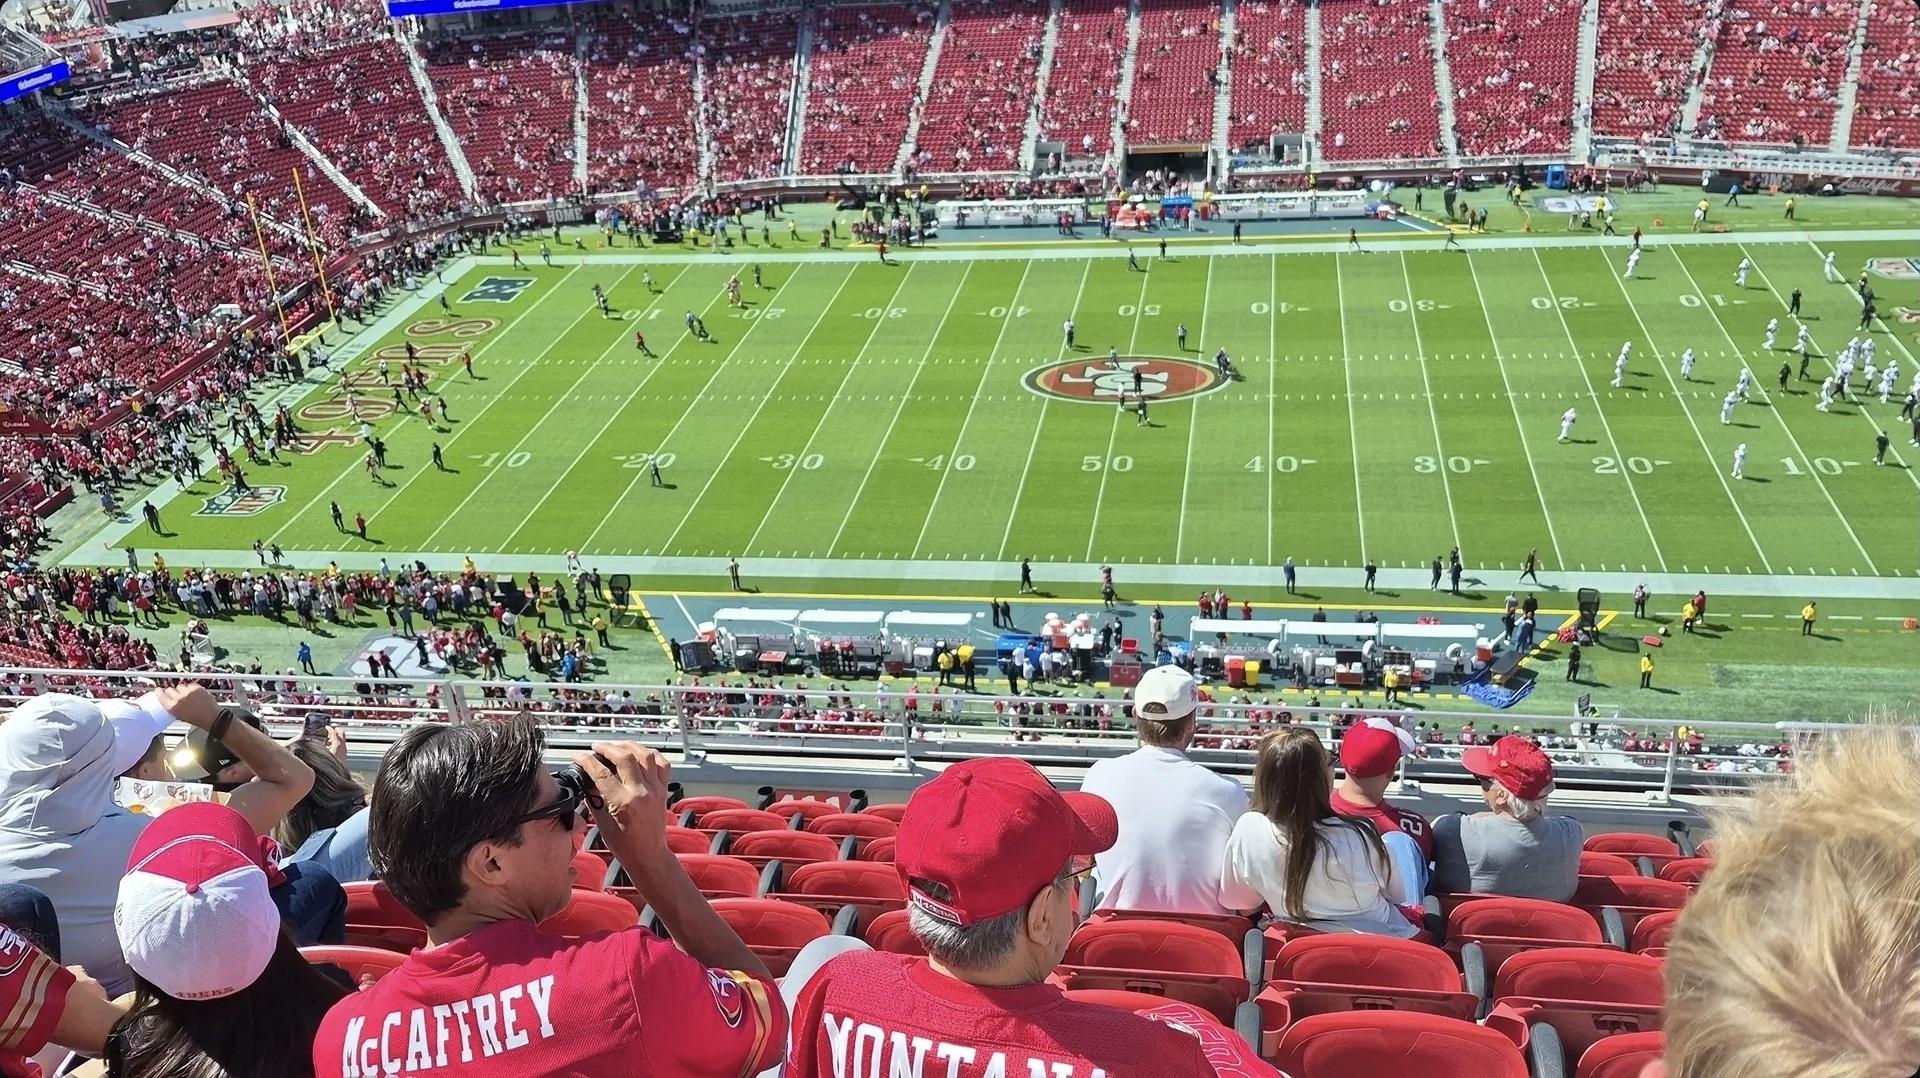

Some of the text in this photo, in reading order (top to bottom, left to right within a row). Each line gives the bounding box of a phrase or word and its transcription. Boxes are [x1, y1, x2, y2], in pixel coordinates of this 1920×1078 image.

[546, 207, 583, 223] HOME
[1251, 302, 1293, 314] 40
[1389, 300, 1435, 312] 30
[1531, 296, 1579, 309] 20
[1679, 294, 1727, 307] 10
[621, 309, 663, 320] 10
[743, 308, 787, 320] 20
[864, 308, 908, 318] 30
[989, 306, 1032, 317] 40
[1118, 305, 1161, 316] 50
[477, 452, 531, 468] 10
[621, 452, 677, 468] 20
[774, 453, 825, 470] 30
[925, 454, 977, 470] 40
[1081, 455, 1133, 472] 50
[1244, 455, 1298, 472] 40
[1414, 456, 1471, 473] 30
[1591, 456, 1654, 474] 20
[1779, 457, 1843, 475] 10
[823, 1012, 1108, 1078] MONT
